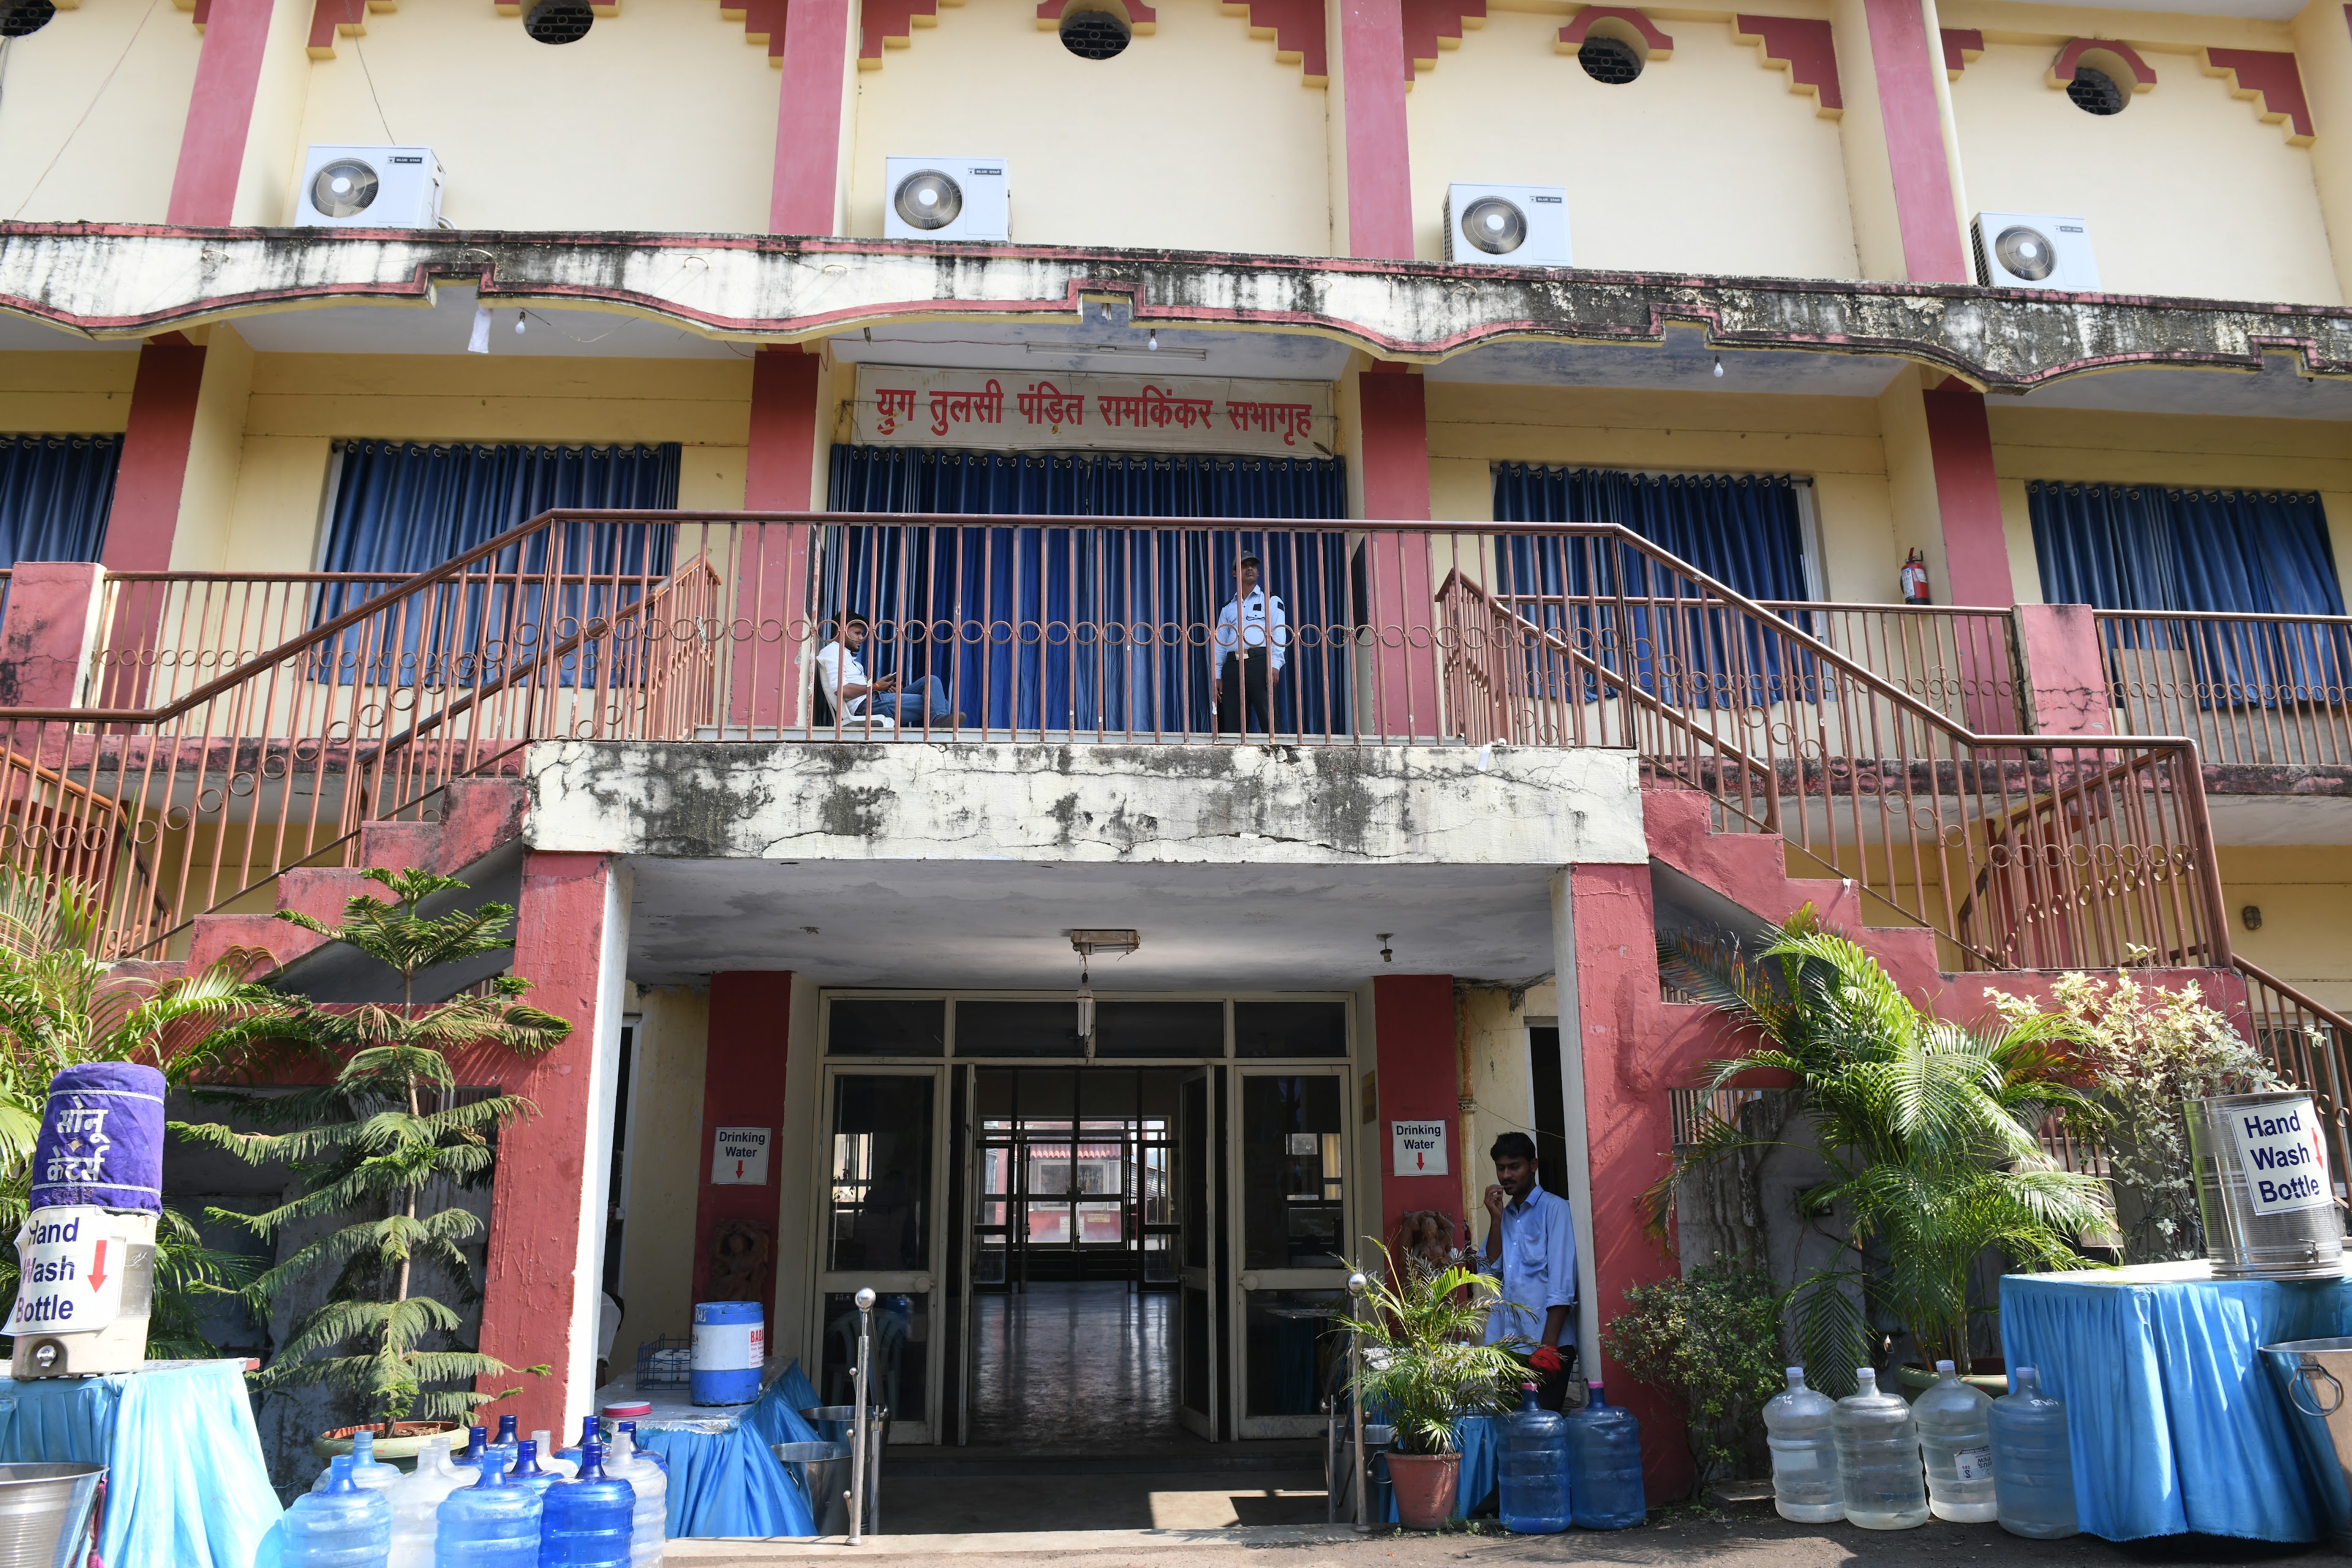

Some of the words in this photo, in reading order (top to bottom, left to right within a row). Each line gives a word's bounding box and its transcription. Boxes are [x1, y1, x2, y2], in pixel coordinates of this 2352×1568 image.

[875, 389, 917, 435] युग
[929, 379, 1004, 436] तुलसी
[1017, 382, 1084, 425] पंडित
[1098, 385, 1213, 429] रामकिंकर
[1227, 401, 1312, 445] सभागृह
[57, 1095, 110, 1144] सोनू
[1396, 1125, 1441, 1136] Drinking
[2244, 1110, 2301, 1139] Hand
[719, 1131, 765, 1145] Drinking
[726, 1147, 757, 1157] Water
[1404, 1139, 1434, 1149] Water
[47, 1145, 110, 1181] केटर्स
[2250, 1143, 2310, 1170] Wash
[2258, 1175, 2319, 1203] Bottle
[28, 1217, 80, 1246] Hand
[23, 1256, 75, 1284] Wash
[16, 1294, 73, 1323] Bottle
